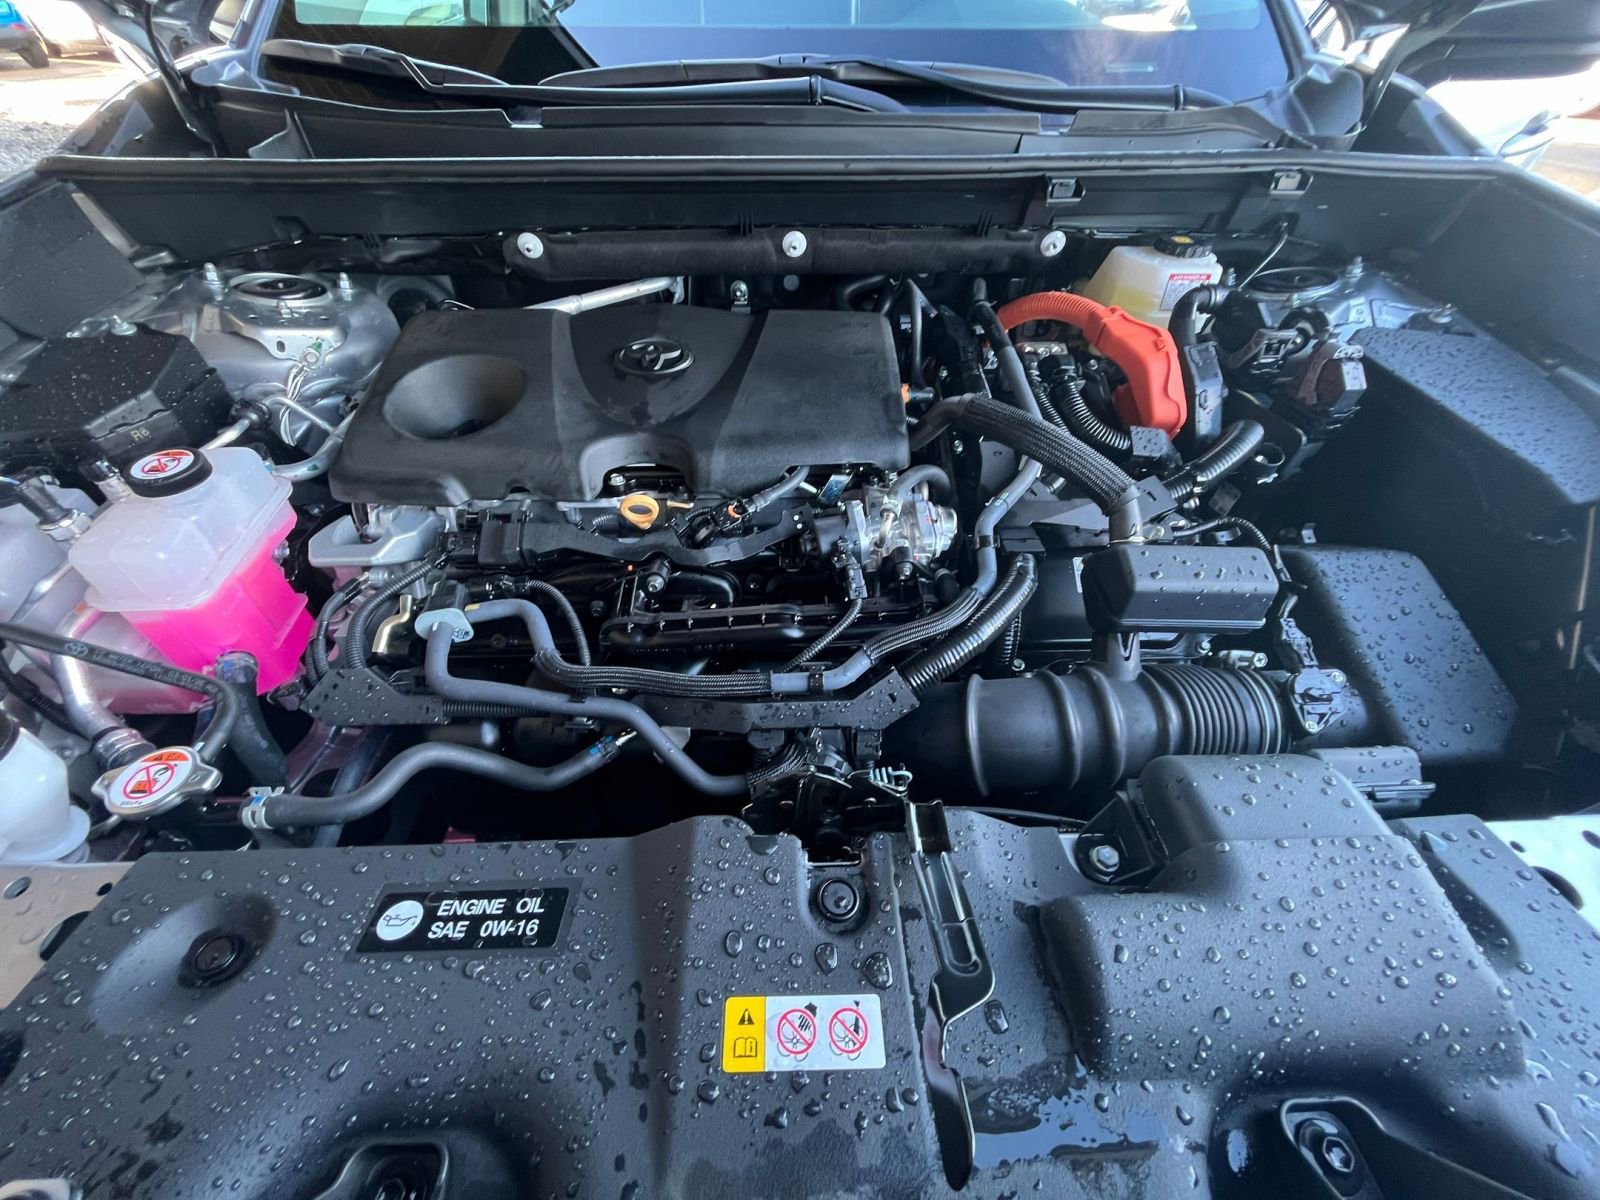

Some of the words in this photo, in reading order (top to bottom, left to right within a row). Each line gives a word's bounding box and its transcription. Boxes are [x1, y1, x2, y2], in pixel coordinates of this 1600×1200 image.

[437, 898, 507, 916] ENGINE
[516, 897, 545, 914] OIL
[427, 921, 470, 938] SAE
[479, 919, 539, 937] 0W-16
